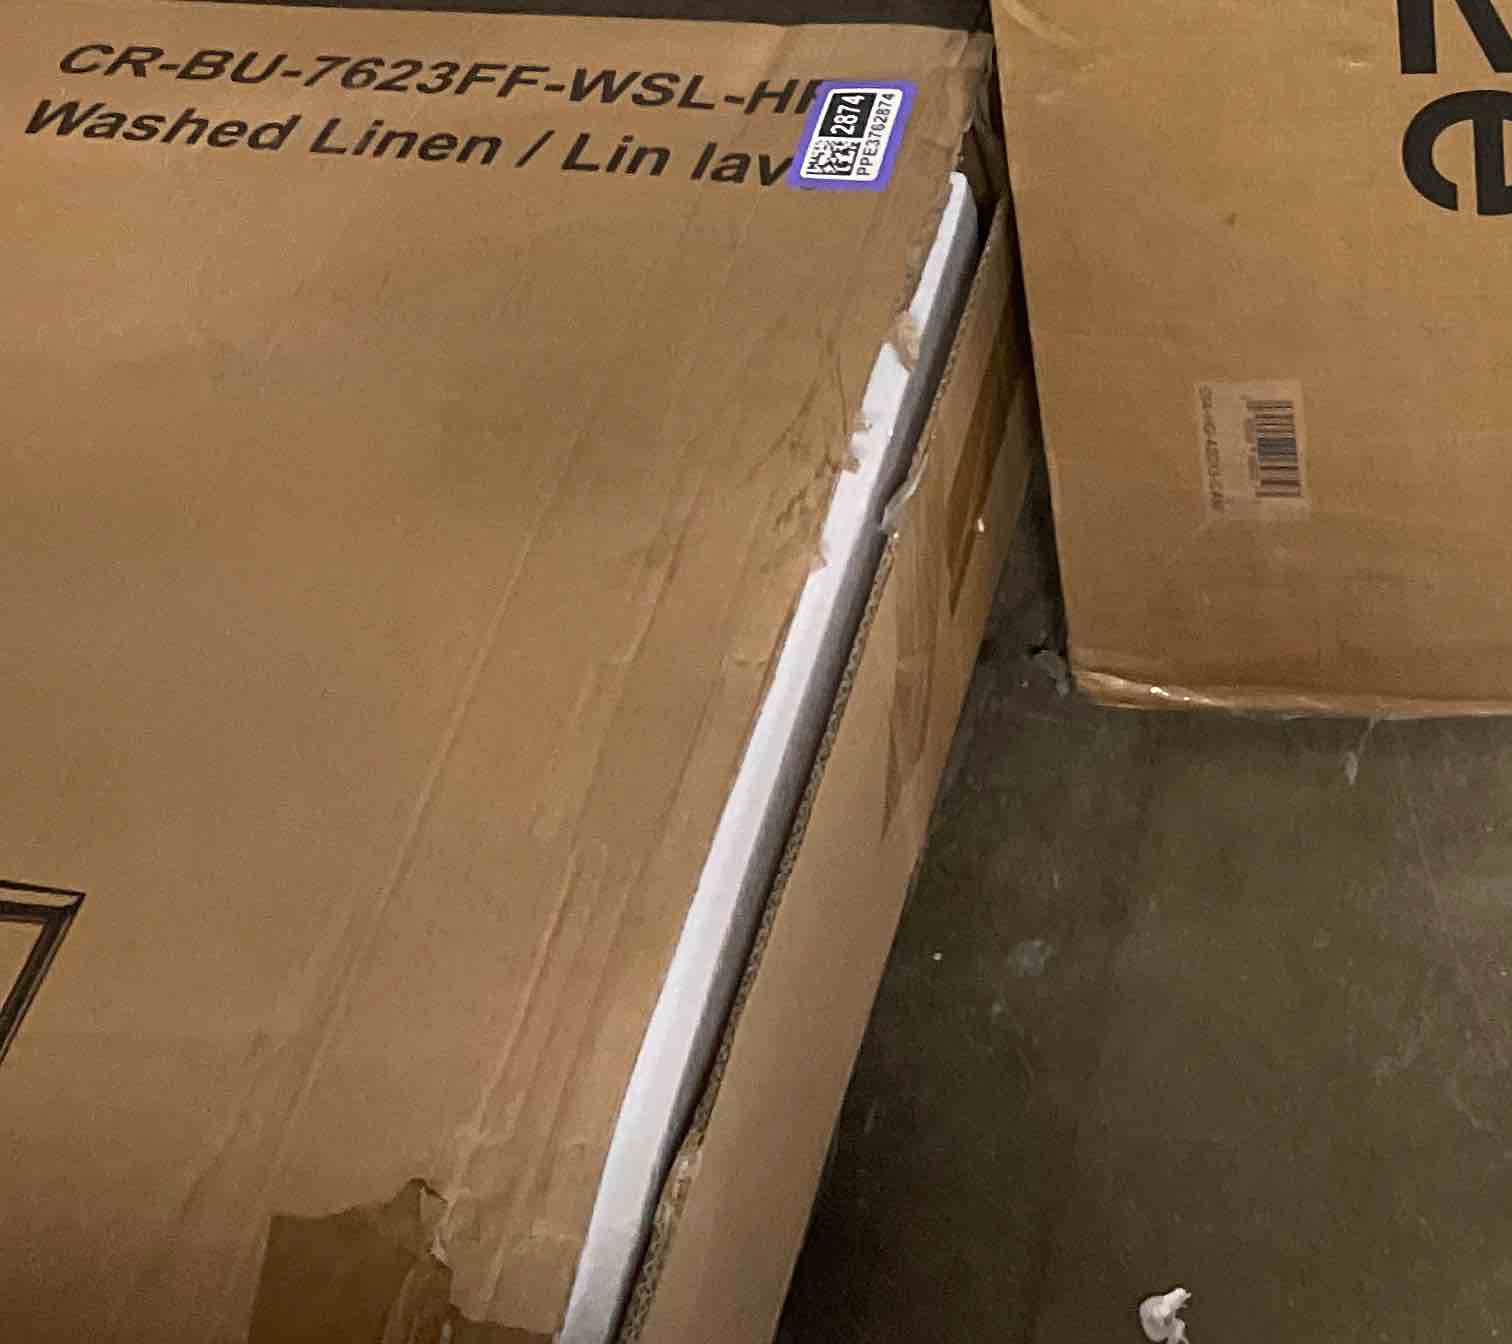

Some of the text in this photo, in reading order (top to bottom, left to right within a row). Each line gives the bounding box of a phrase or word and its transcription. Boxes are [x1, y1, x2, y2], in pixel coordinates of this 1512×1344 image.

[25, 98, 301, 152] Washed
[309, 116, 503, 167] Linen
[561, 132, 671, 177] Lin
[830, 94, 865, 136] 2874
